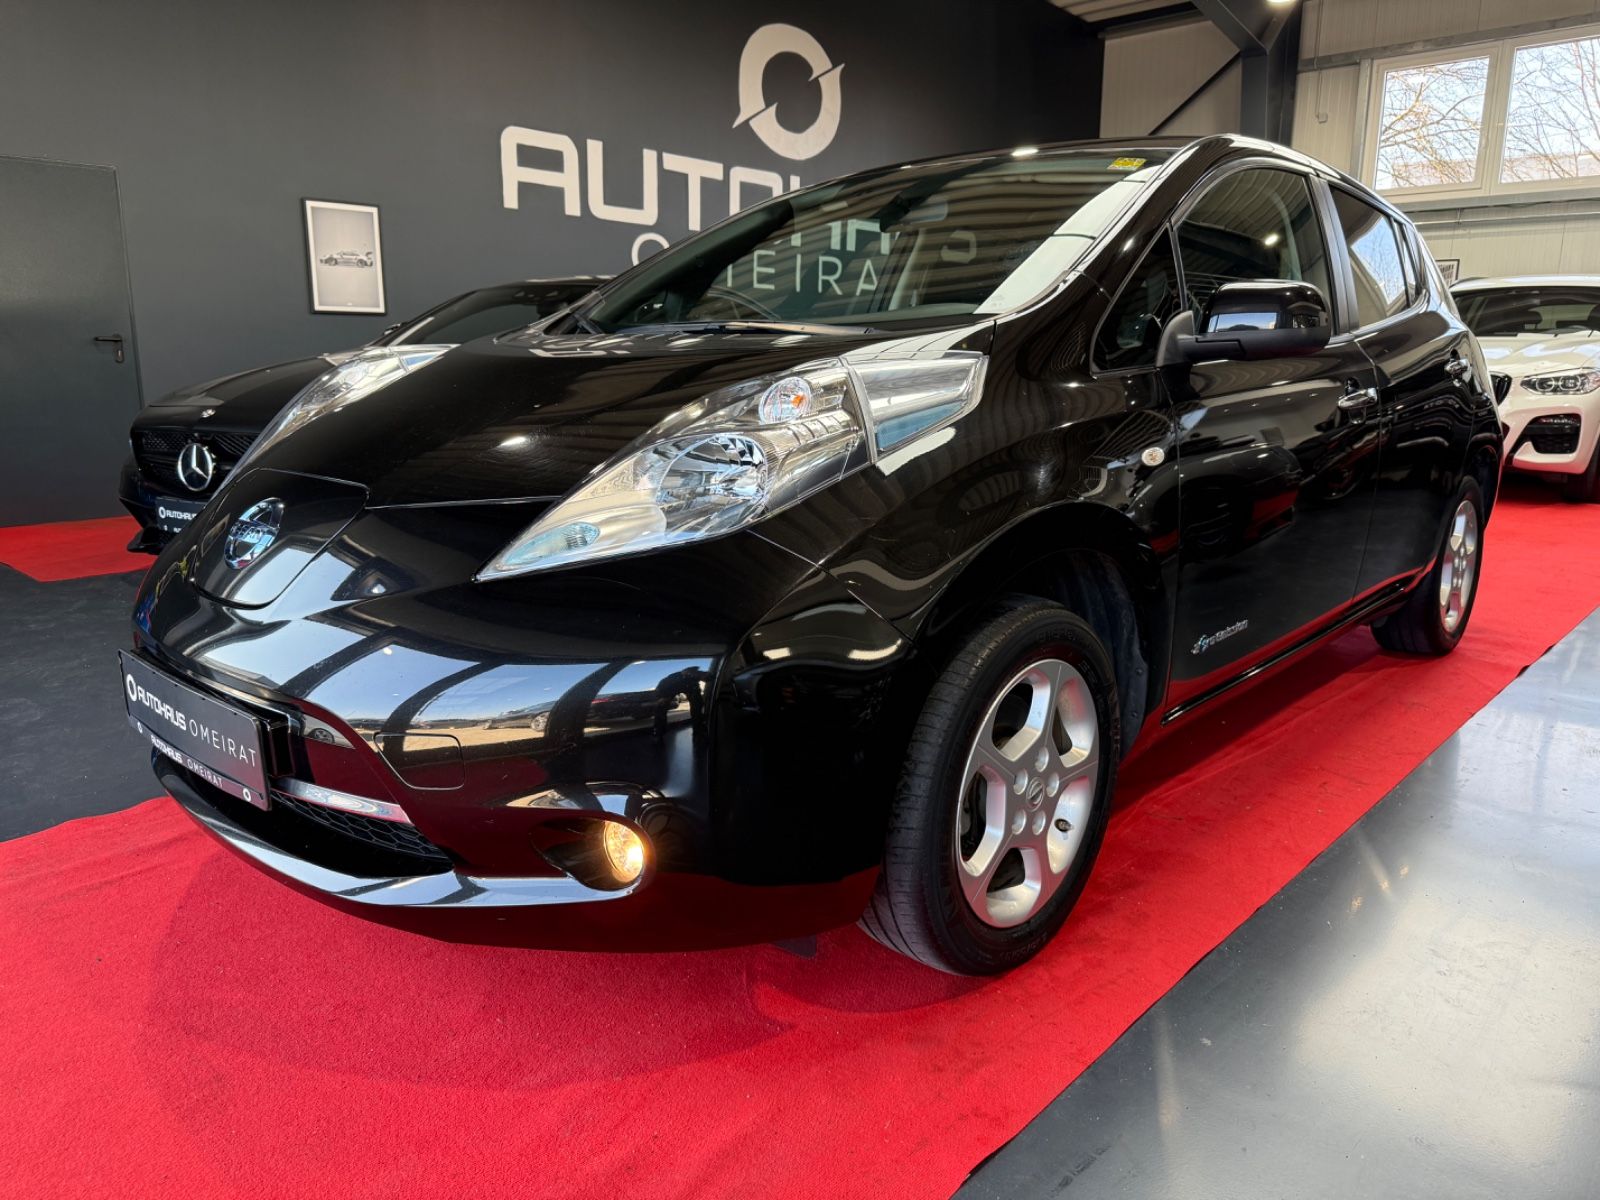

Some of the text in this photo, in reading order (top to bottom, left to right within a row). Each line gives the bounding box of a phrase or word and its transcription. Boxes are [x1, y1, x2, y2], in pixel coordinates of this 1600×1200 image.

[137, 686, 257, 768] AUTOHAUS OMEIRAT
[187, 758, 223, 788] OMEIRAT
